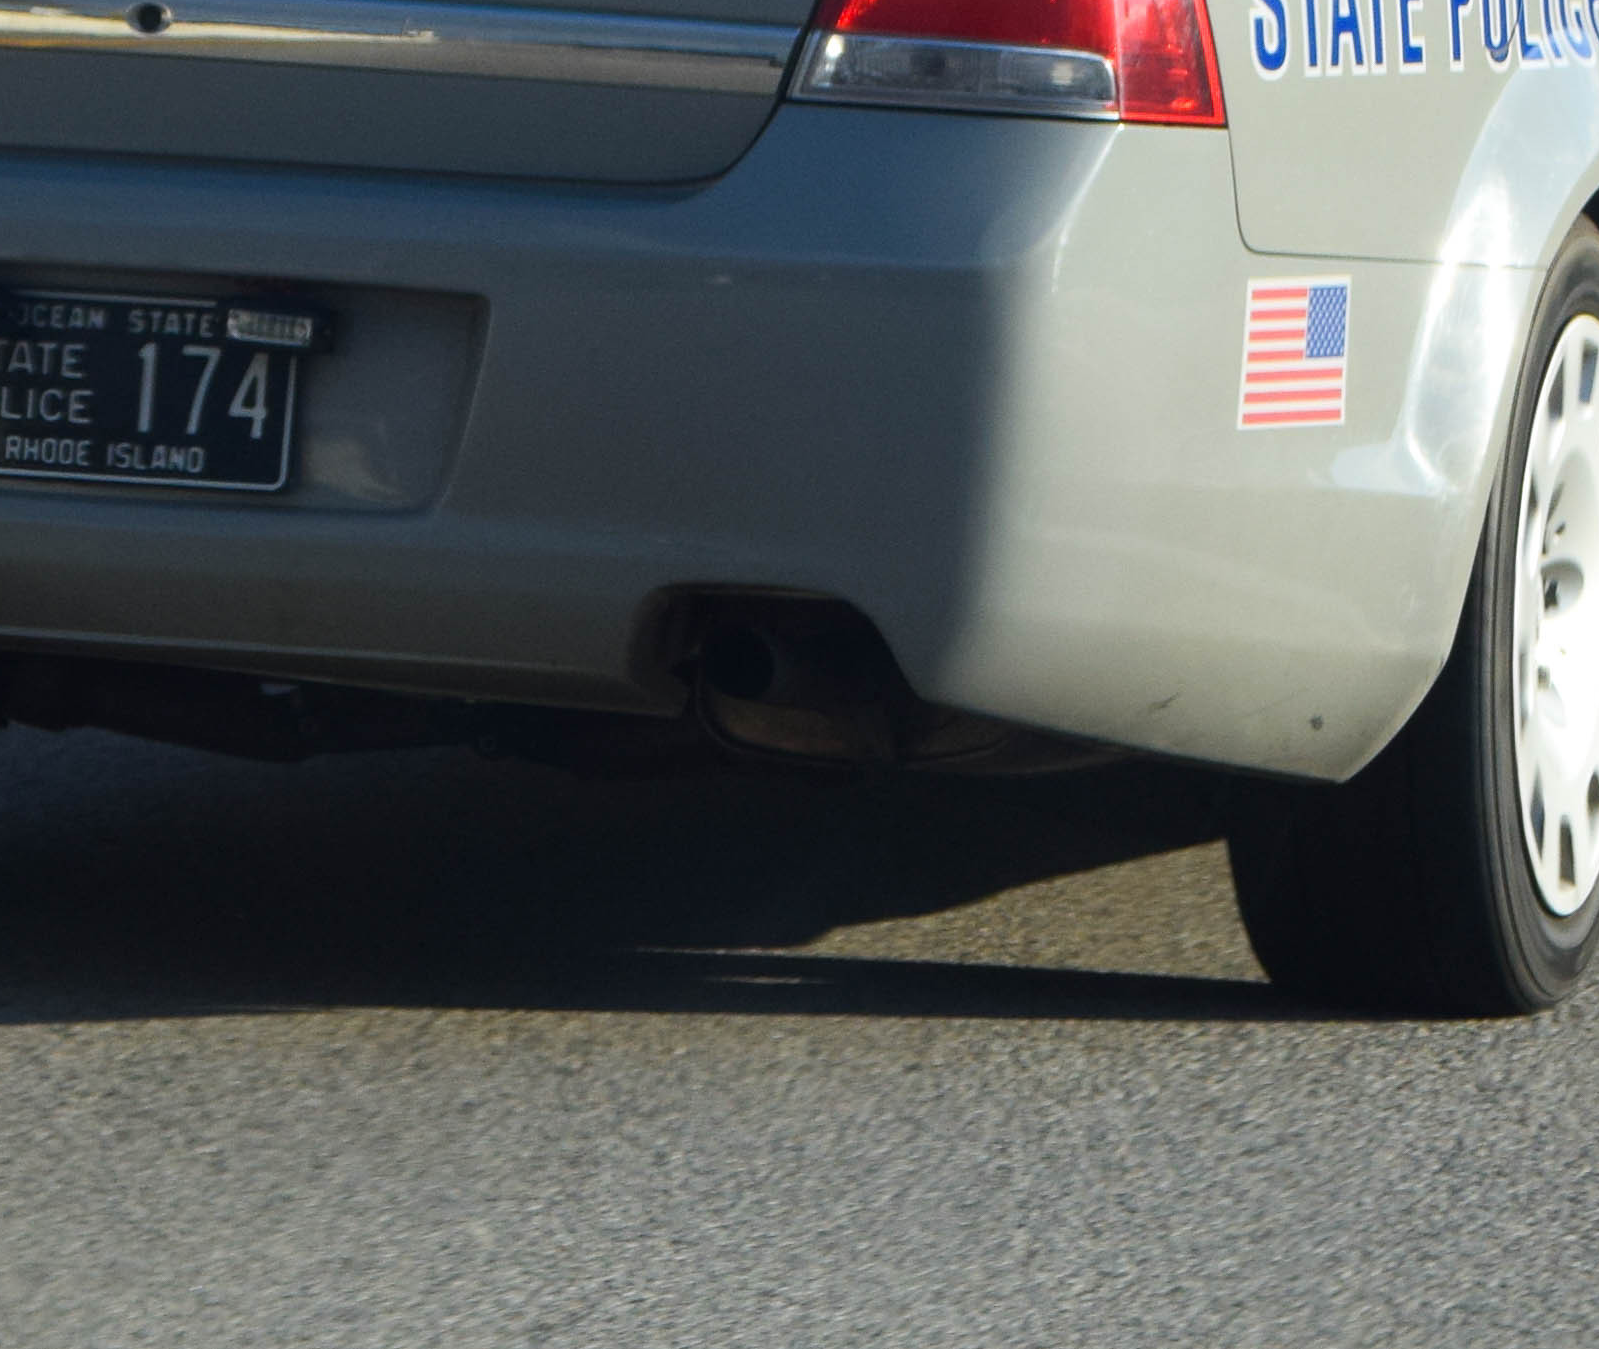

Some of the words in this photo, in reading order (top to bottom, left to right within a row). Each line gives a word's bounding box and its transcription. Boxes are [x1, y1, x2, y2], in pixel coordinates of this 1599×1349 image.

[126, 308, 215, 338] STATE
[137, 342, 270, 440] 174
[4, 435, 92, 467] RHODE
[107, 443, 205, 474] ISLAND
